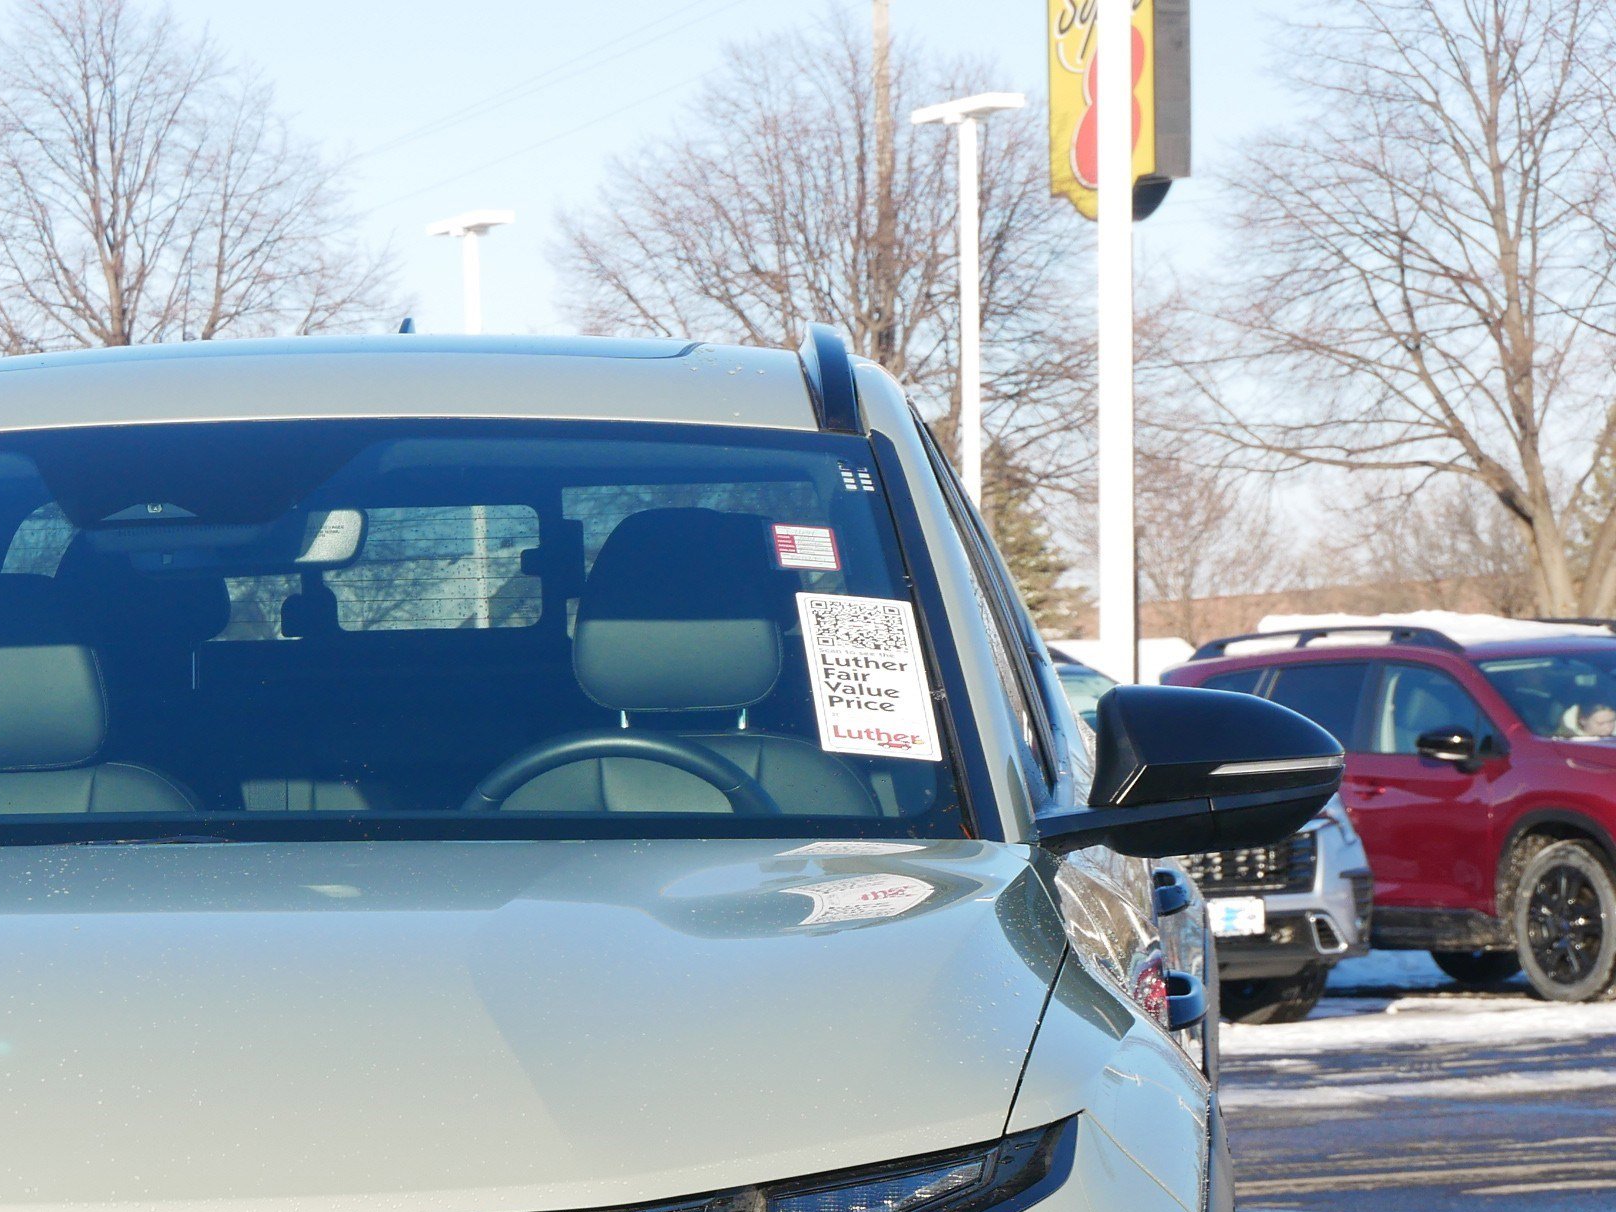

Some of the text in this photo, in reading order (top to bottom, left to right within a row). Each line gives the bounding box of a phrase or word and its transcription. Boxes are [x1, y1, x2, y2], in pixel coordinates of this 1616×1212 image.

[821, 653, 908, 671] Luther
[824, 667, 870, 681] Fair
[824, 681, 900, 698] Value
[828, 695, 895, 712] Price
[833, 725, 920, 745] Luther
